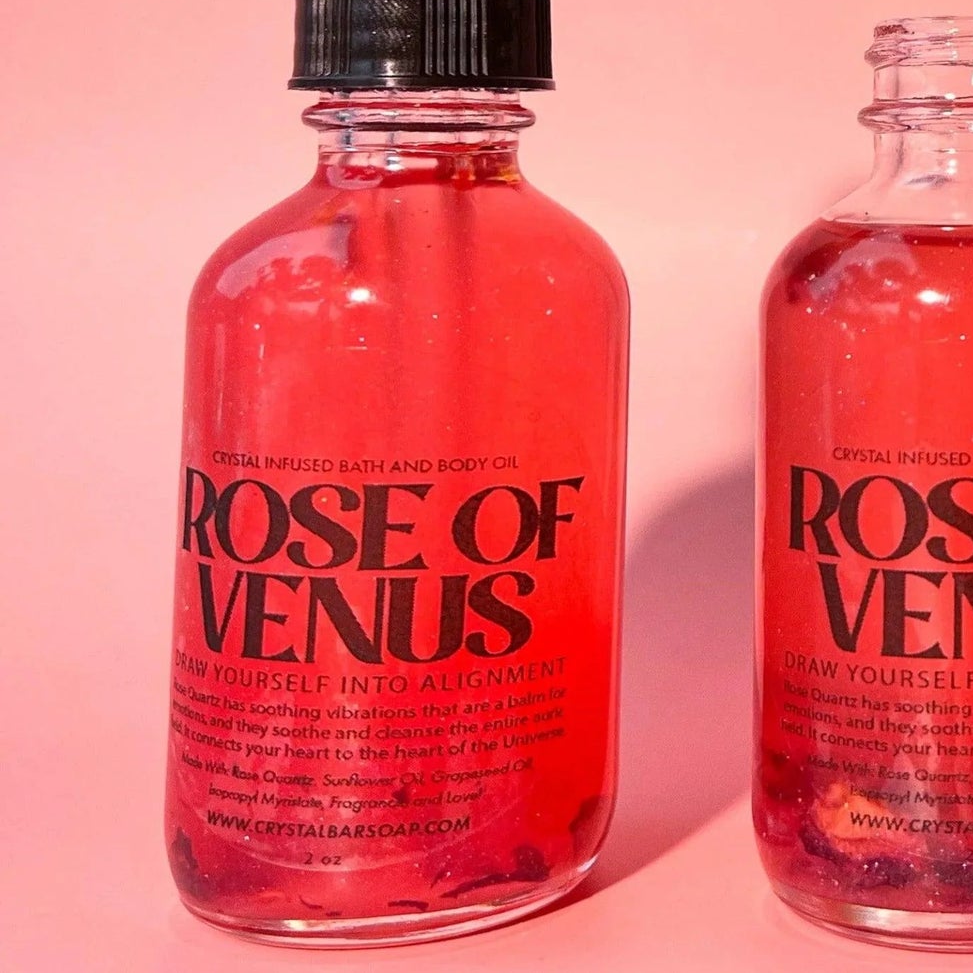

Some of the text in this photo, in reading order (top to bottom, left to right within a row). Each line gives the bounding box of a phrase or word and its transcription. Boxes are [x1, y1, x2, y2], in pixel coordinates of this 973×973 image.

[213, 451, 519, 473] CRYSTAL INFUSED BATH AND BODY OIL
[833, 447, 891, 463] CRYSTAL
[898, 451, 971, 466] INFUSED
[183, 466, 585, 570] ROSE OF
[197, 562, 536, 665] VENUS
[175, 649, 566, 694] DRAW YOURSELF INTO ALIGNMENT
[784, 650, 839, 678] DRAW
[188, 686, 566, 722] Quartz has soothing vibrations that are a balm for
[810, 687, 858, 708] Quartz
[861, 694, 890, 711] has
[894, 700, 972, 719] soothing
[209, 715, 233, 728] and
[236, 717, 269, 739] they
[272, 724, 331, 739] soothe
[334, 725, 371, 740] and
[375, 725, 444, 739] cleanse
[450, 720, 478, 736] the
[483, 715, 529, 732] entire
[784, 702, 841, 726] emotions,
[846, 717, 875, 731] and
[880, 717, 917, 738] they
[191, 730, 242, 752] connects
[245, 743, 281, 757] your
[284, 743, 330, 760] heart
[335, 747, 354, 761] to
[359, 745, 389, 760] the
[394, 743, 444, 760] heart
[449, 740, 467, 755] of
[471, 738, 498, 753] the
[808, 727, 818, 740] It
[820, 731, 889, 752] connects
[893, 742, 931, 757] your
[231, 764, 260, 781] Rose
[322, 772, 396, 787] Sunflower
[431, 762, 510, 785] Grapeseed
[807, 754, 840, 771] Made
[877, 766, 910, 781] Rose
[208, 782, 259, 805] Isopropyl
[261, 792, 325, 810] Myristate,
[413, 793, 443, 806] and
[207, 810, 471, 838] WWW.CRYSTALBARSOAP.COM
[303, 852, 342, 865] 2 oz
[965, 849, 973, 861] 2
